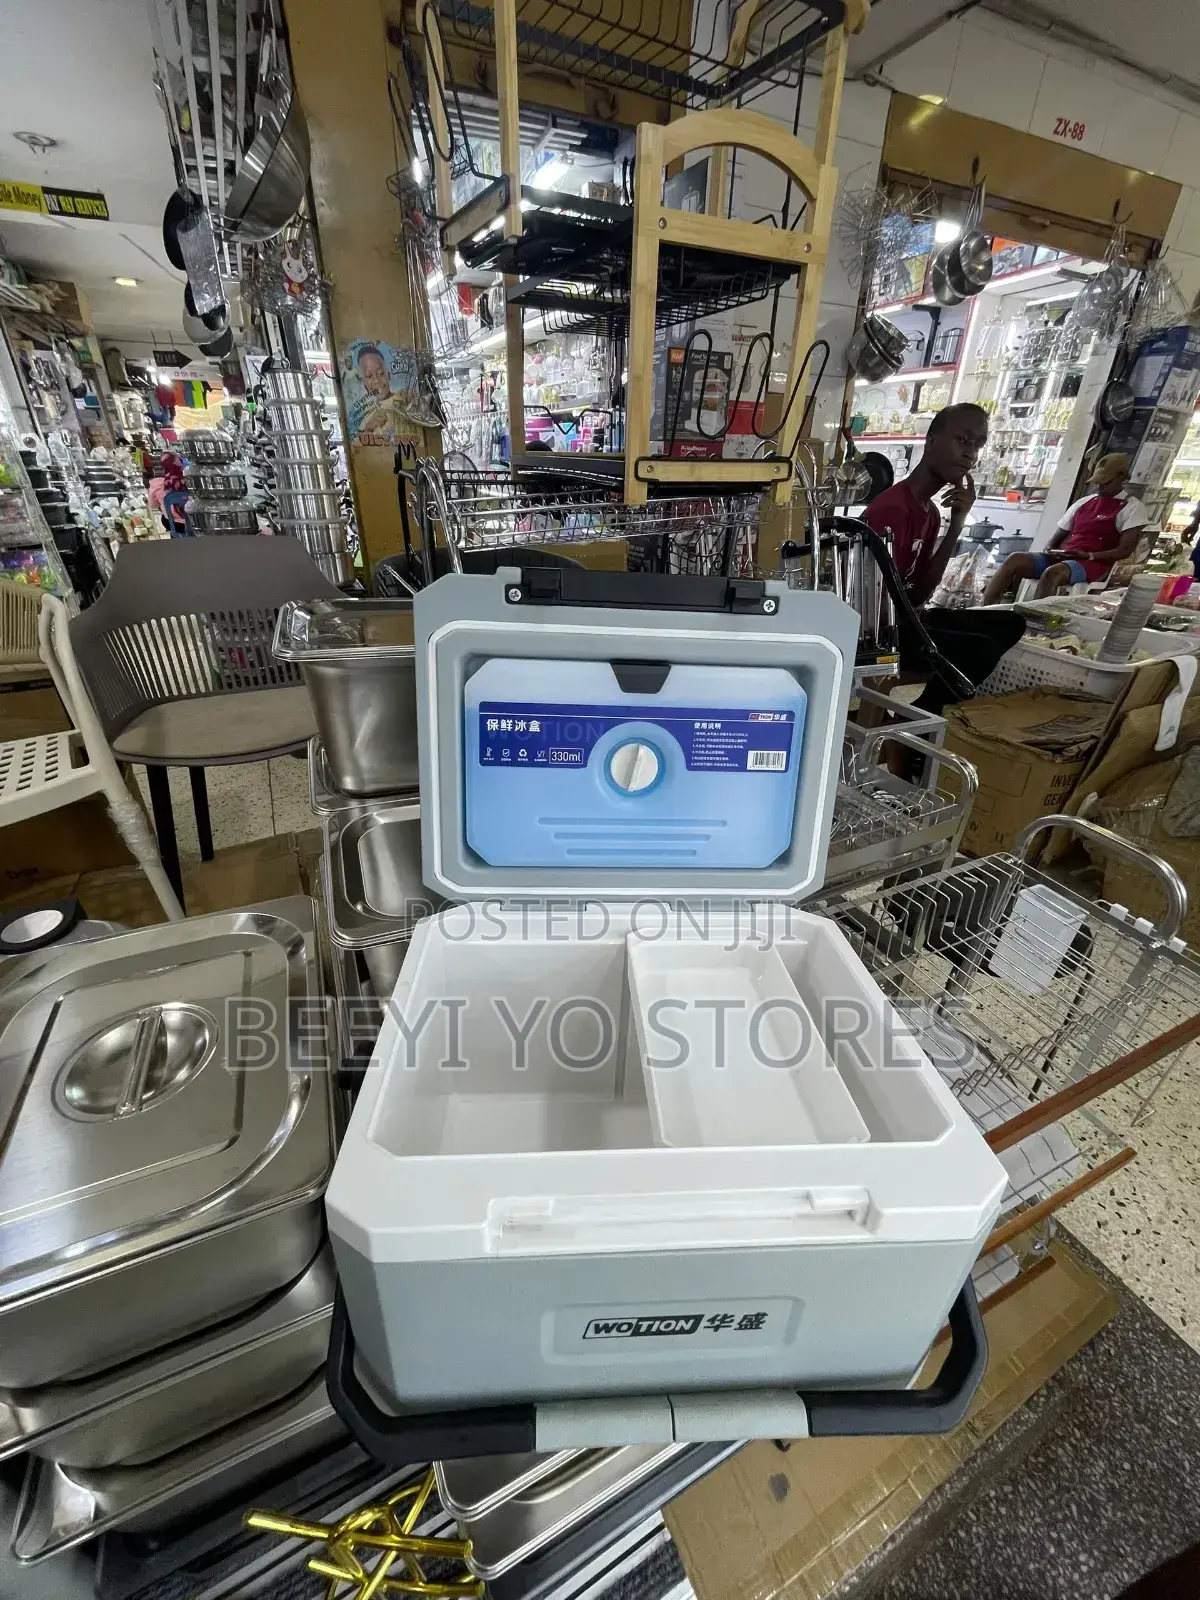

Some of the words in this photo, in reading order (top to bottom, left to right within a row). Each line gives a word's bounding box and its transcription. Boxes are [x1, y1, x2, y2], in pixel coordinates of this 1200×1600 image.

[1053, 117, 1086, 141] ZX-88
[12, 185, 43, 212] Money
[486, 718, 541, 732] 保鲜冰盒
[693, 722, 722, 730] 使用说明
[551, 751, 582, 762] 330ml
[592, 1317, 697, 1336] WOTION
[703, 1312, 769, 1332] 华盛
